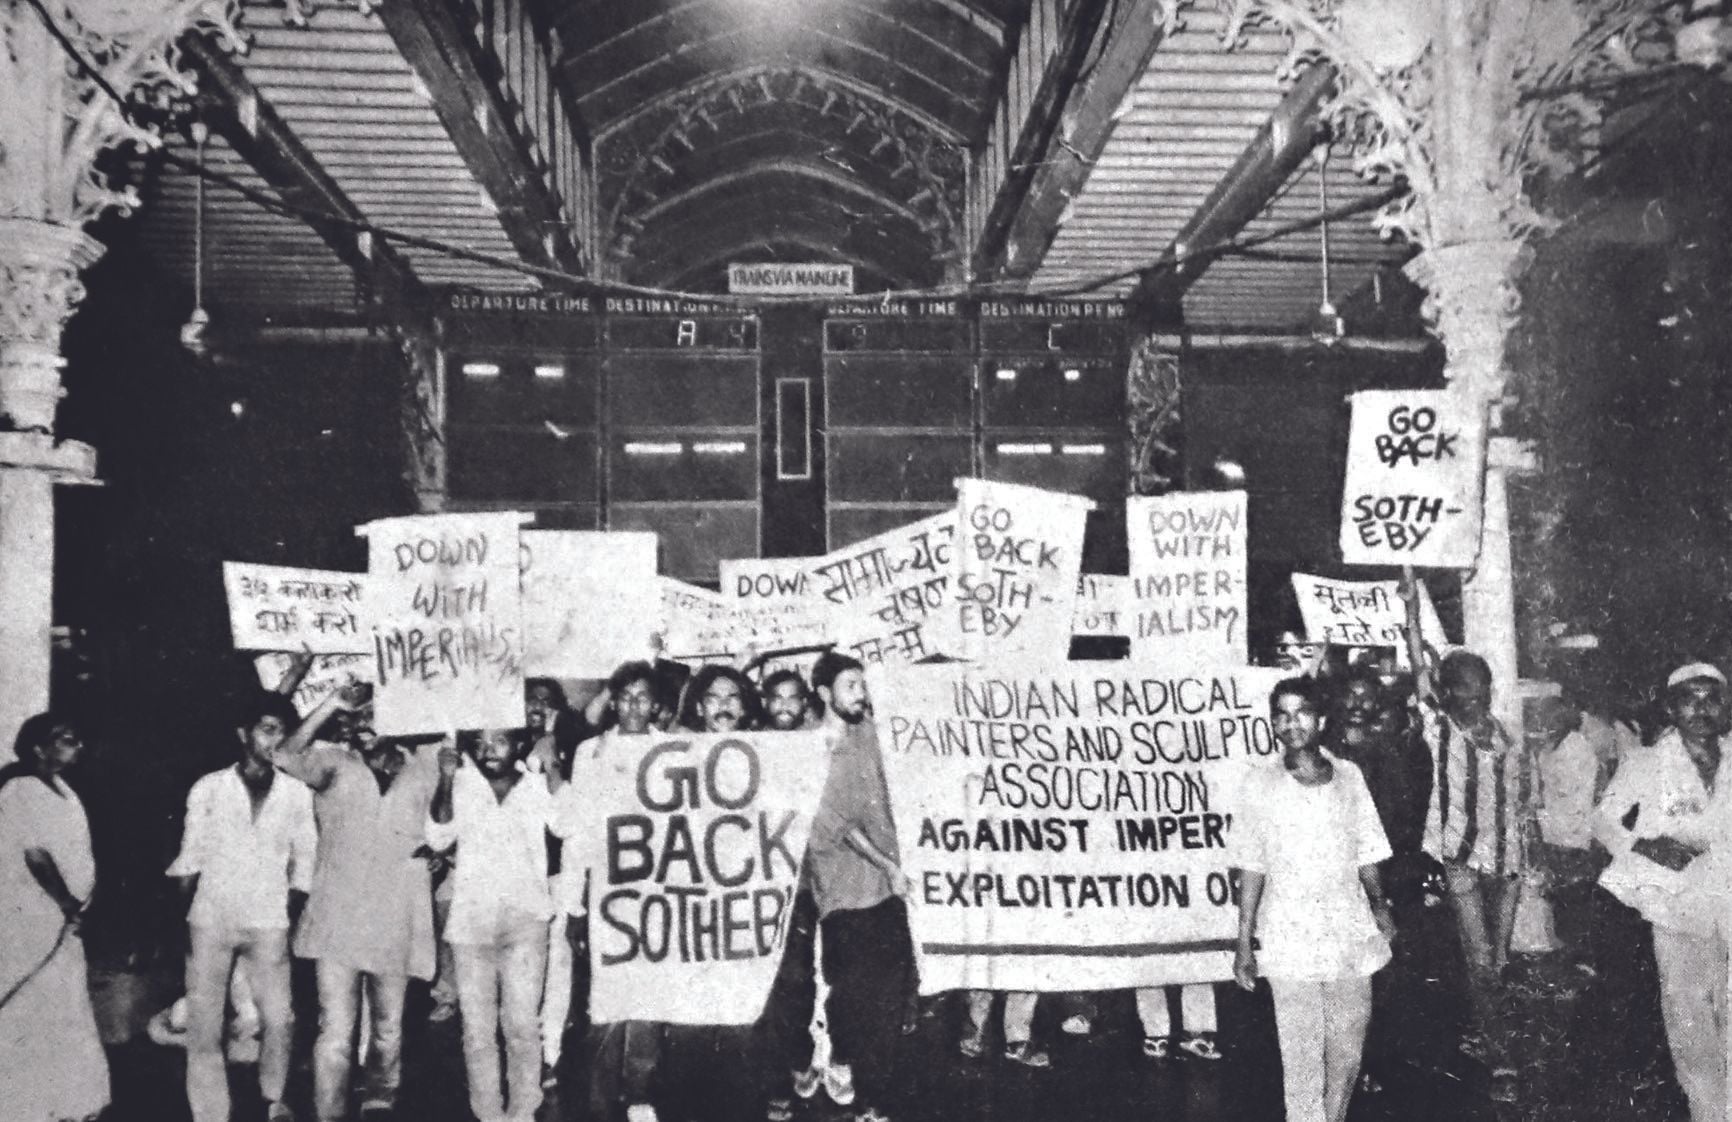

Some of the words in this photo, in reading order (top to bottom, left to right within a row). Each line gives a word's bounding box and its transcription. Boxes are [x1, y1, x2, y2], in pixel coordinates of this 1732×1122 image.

[553, 296, 589, 312] TIME
[1388, 405, 1436, 435] GO
[1375, 433, 1458, 468] BACK
[970, 504, 1011, 532] GO
[1151, 504, 1240, 536] DOWN
[1358, 520, 1432, 551] EBY
[395, 533, 487, 572] DOWN
[973, 533, 1059, 568] BACK
[1154, 535, 1231, 559] WITH
[414, 578, 487, 618] WITH
[959, 604, 1022, 639] EBY
[1138, 606, 1239, 644] IALISM
[953, 679, 1079, 720] INDIAN
[1095, 676, 1253, 717] RADICAL
[890, 716, 1060, 763] PAINTERS
[1065, 725, 1123, 764] AND
[636, 738, 762, 814] GO
[978, 762, 1209, 815] ASSOCIATION
[606, 809, 799, 888] BACK
[917, 817, 1089, 853] AGAINST
[923, 871, 1188, 908] EXPLOITATION
